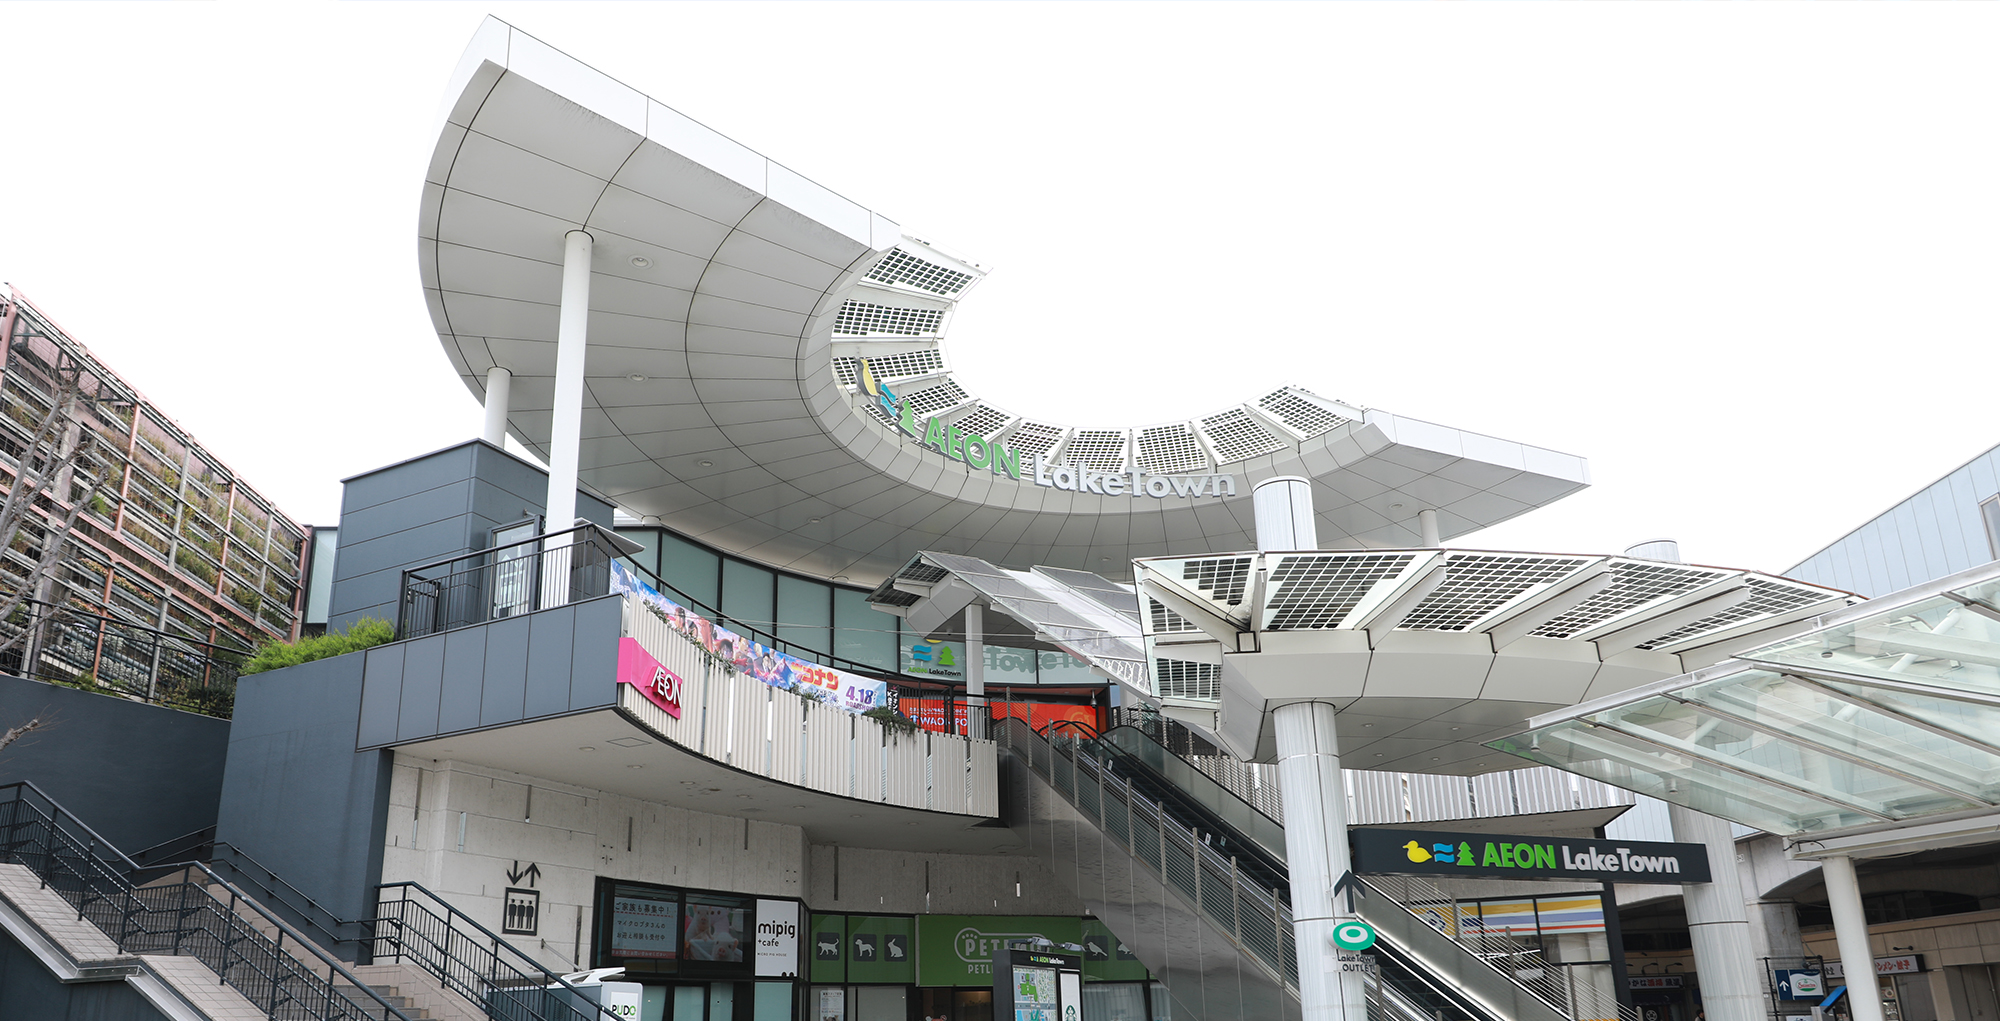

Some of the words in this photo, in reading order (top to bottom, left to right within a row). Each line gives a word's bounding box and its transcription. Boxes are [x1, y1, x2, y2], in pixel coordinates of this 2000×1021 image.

[923, 416, 1020, 480] AEON
[1033, 454, 1235, 498] LakeTown
[801, 666, 839, 691] コナン
[928, 668, 962, 676] LakeTown
[845, 685, 874, 705] 4.18
[1482, 842, 1557, 869] AEON
[1561, 845, 1680, 873] LakeTown
[758, 920, 795, 939] mipig
[1342, 963, 1374, 972] OUTLET
[612, 1004, 636, 1016] PUDO
